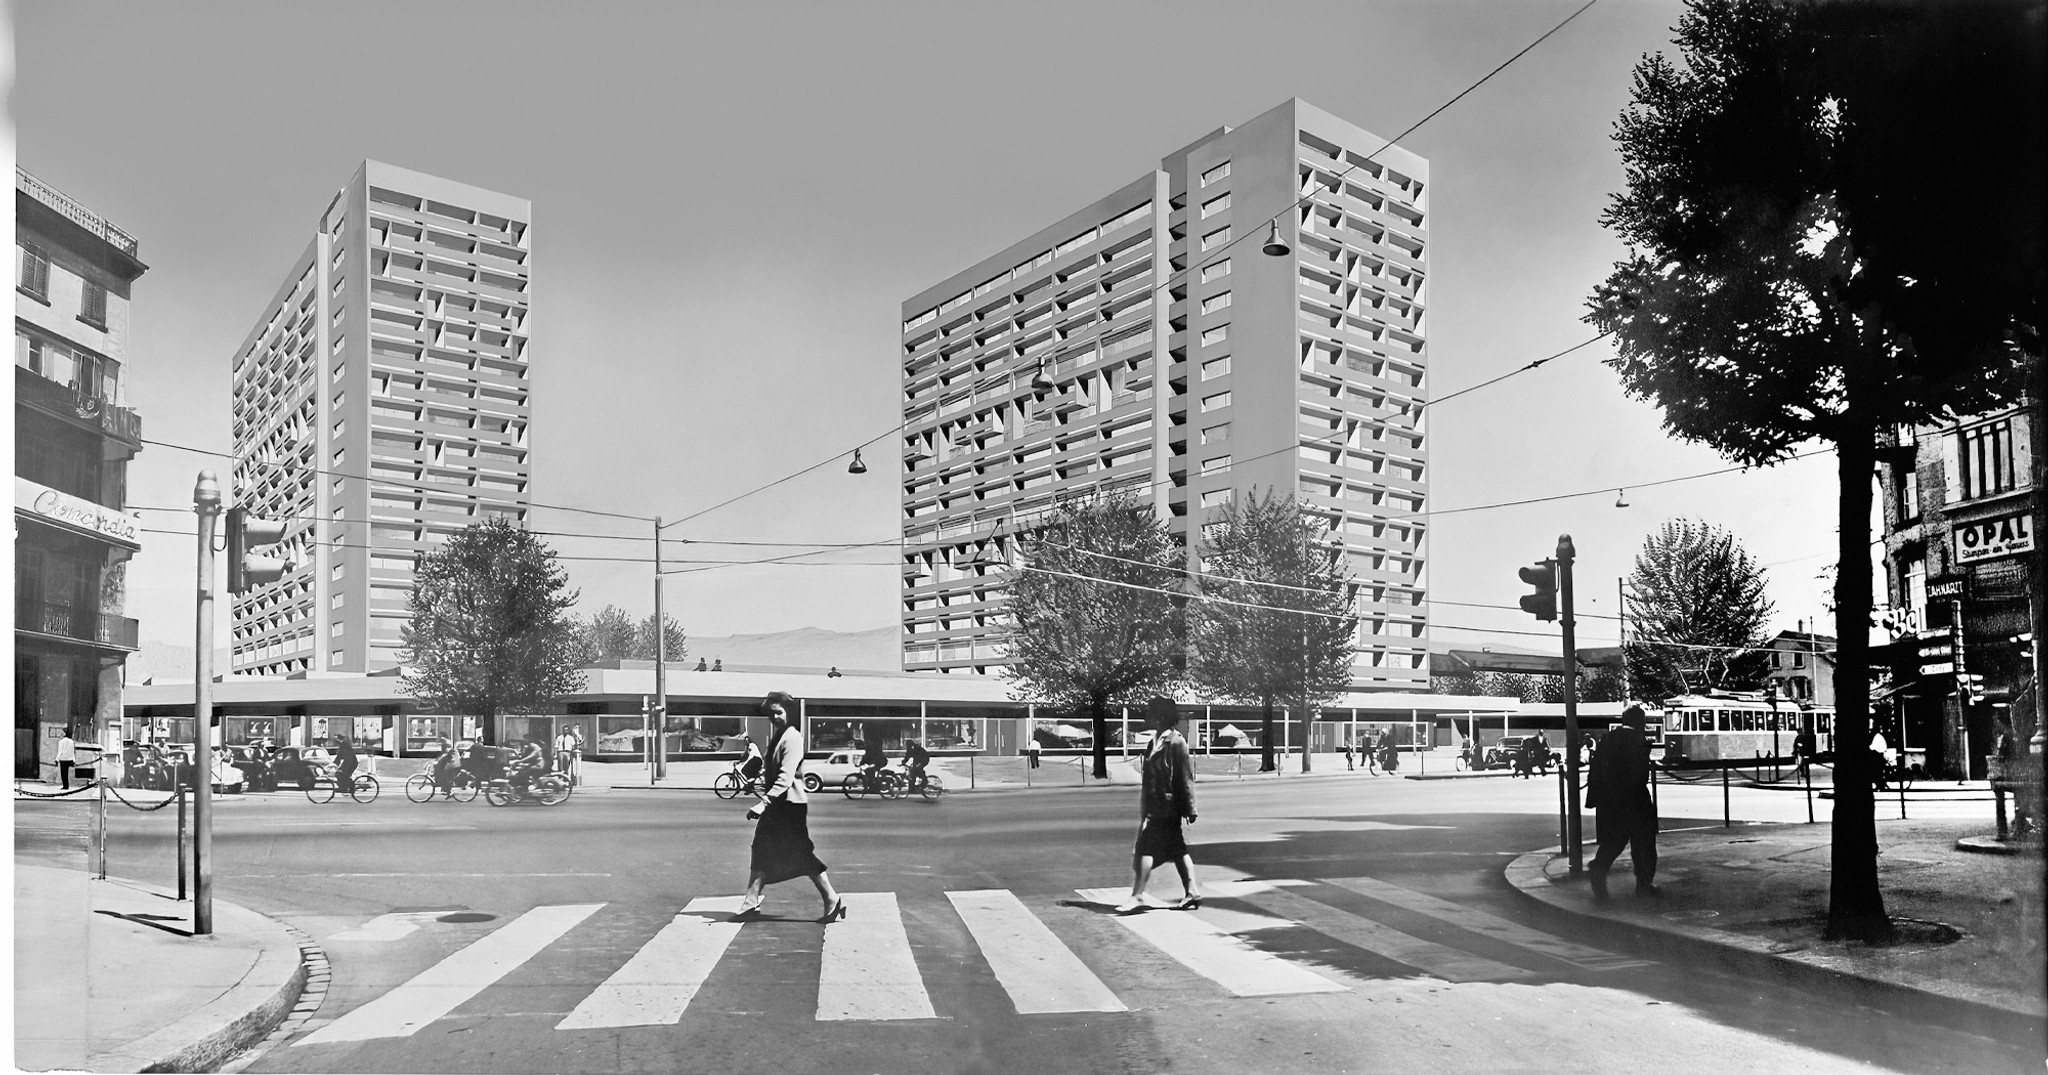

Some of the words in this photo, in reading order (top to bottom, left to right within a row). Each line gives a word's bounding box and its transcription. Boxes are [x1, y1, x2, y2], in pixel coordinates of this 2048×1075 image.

[33, 490, 135, 539] Concordia
[1963, 516, 2028, 548] OPAL
[1927, 581, 1963, 597] ZAHNARZT
